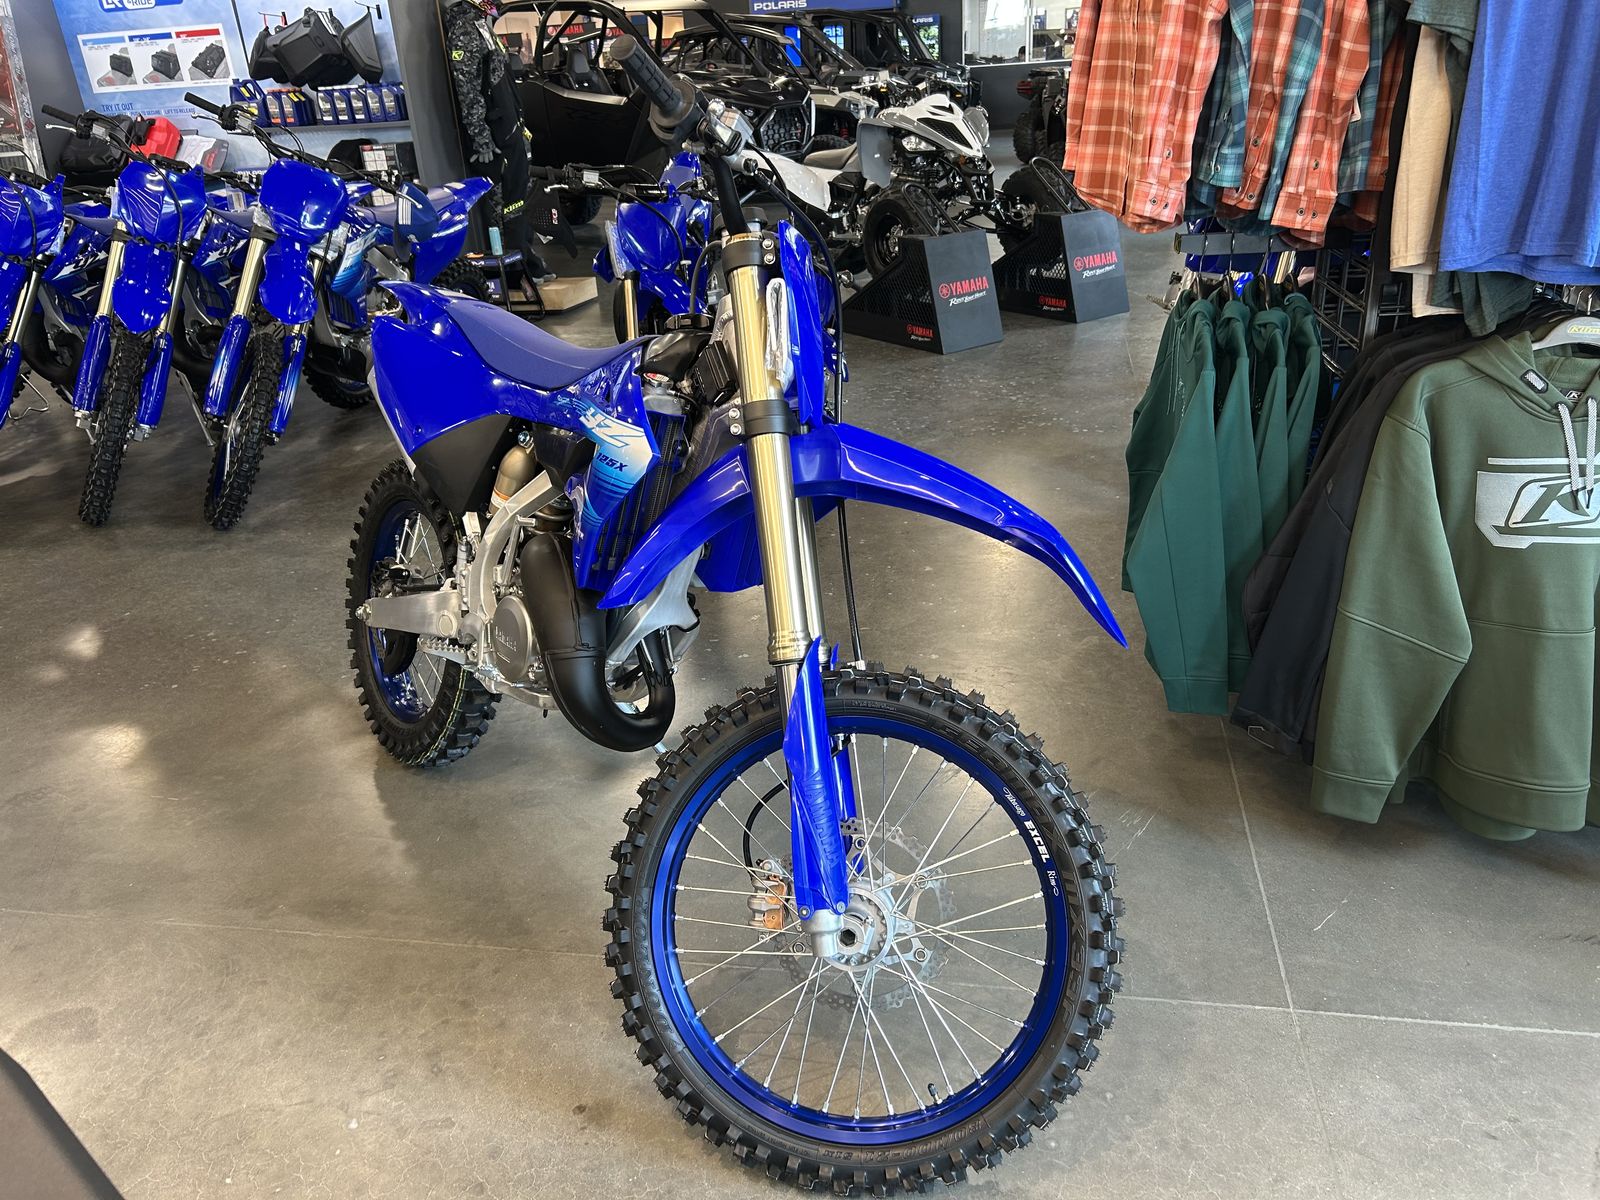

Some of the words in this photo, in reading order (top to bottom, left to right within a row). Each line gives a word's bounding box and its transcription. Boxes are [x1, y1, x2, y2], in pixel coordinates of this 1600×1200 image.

[754, 0, 807, 11] POLARIS
[1083, 250, 1118, 268] YAMAHA
[949, 276, 989, 295] YAMAHA
[596, 452, 628, 472] 125X
[804, 771, 840, 868] YAMAHA
[1024, 820, 1051, 863] EXCEL
